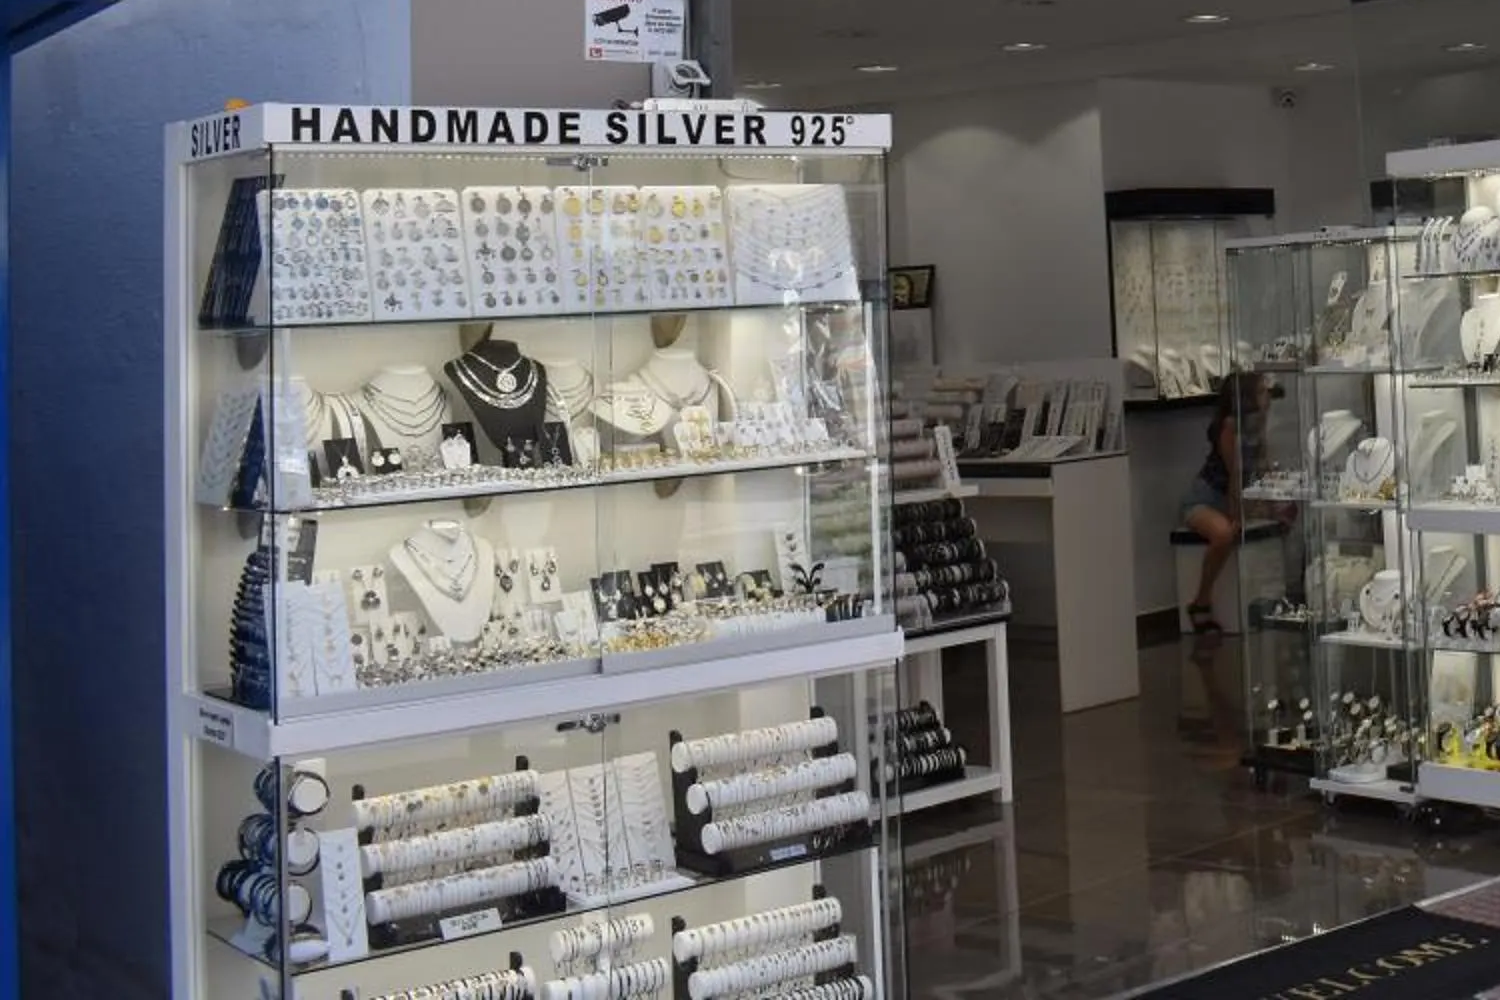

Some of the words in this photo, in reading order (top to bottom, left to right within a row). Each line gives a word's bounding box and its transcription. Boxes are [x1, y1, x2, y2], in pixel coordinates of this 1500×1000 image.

[191, 114, 242, 157] SILVER
[291, 106, 581, 146] HANDMADE
[605, 111, 767, 146] SILVER
